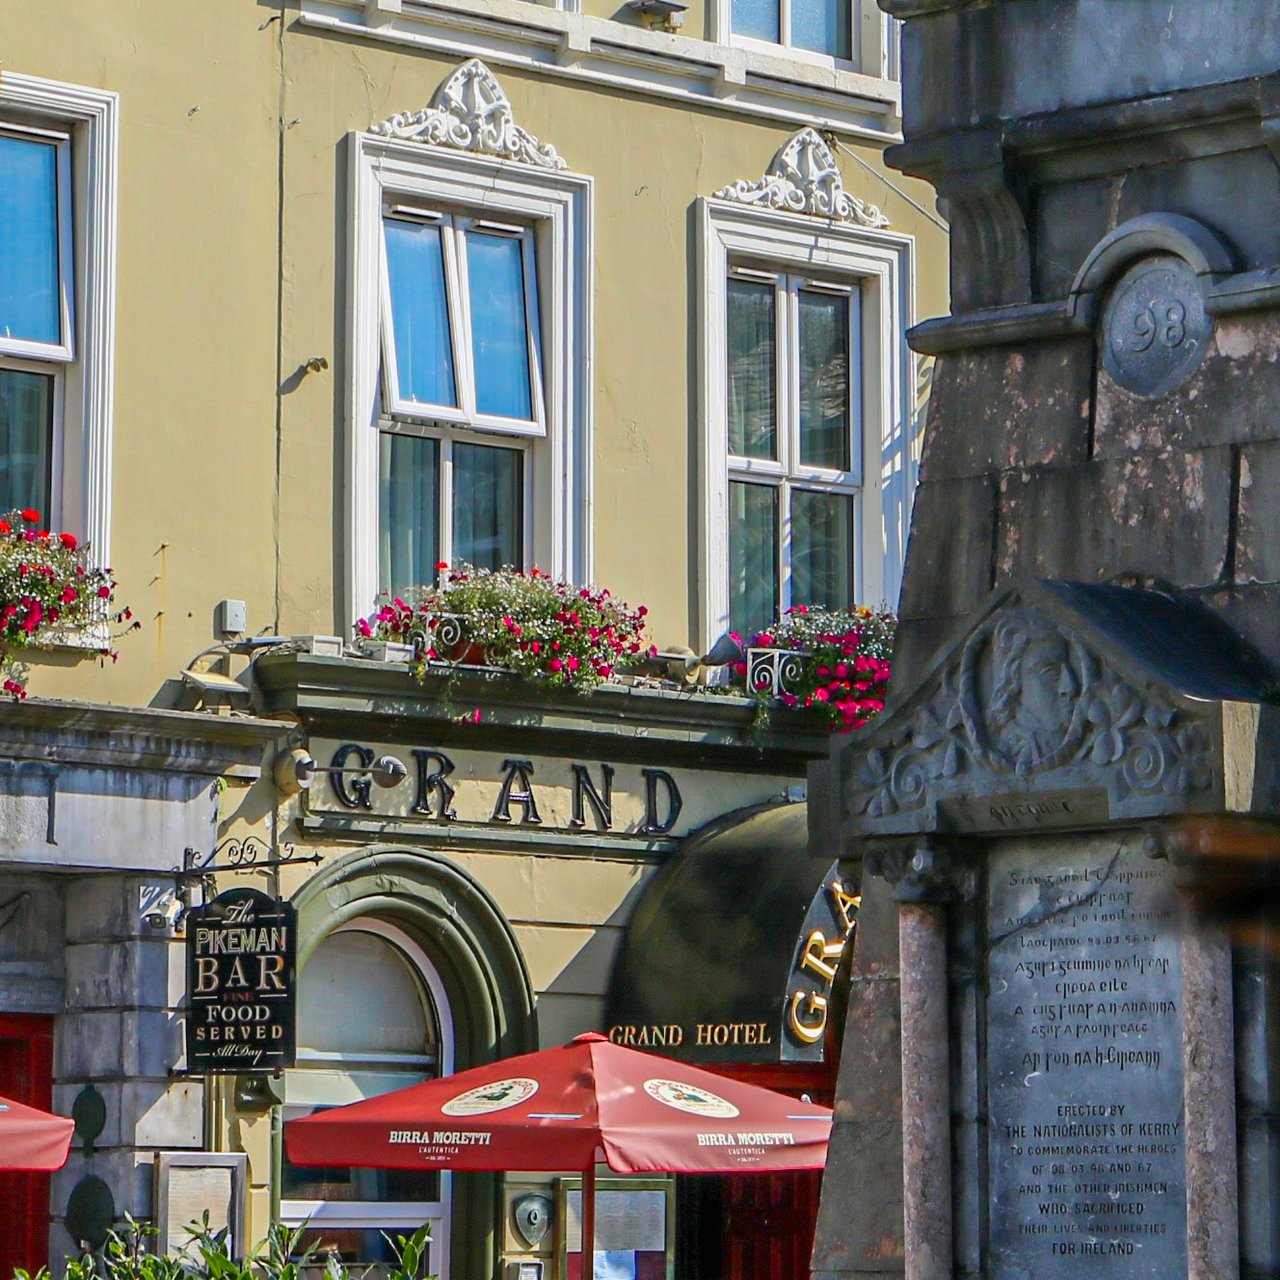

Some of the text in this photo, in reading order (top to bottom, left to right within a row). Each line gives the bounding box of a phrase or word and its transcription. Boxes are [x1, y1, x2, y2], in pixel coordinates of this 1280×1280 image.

[1131, 300, 1186, 352] 98
[329, 743, 683, 836] GRAND
[221, 898, 255, 924] The
[196, 926, 288, 954] PIKEMAN
[194, 954, 287, 993] BAR
[206, 1005, 271, 1023] FOOD
[196, 1025, 283, 1040] SERVED
[609, 1022, 771, 1047] GRAND HOTEL
[1057, 1104, 1125, 1117] ERECTED BY
[1005, 1122, 1180, 1138] THE NATIONALISTS OF KERRY
[389, 1131, 492, 1145] BIRRA MORETTI
[696, 1133, 795, 1146] BIRRA MORETTI
[418, 1146, 460, 1154] L'AUTENTICA
[1010, 1143, 1177, 1156] TO COMMEMORATE THE HEROES
[1032, 1165, 1045, 1175] OF
[1109, 1163, 1131, 1174] AND
[1019, 1182, 1168, 1194] AND THE OTHER IRISHMEN
[1039, 1202, 1145, 1215] WHO SACRIFICED
[1019, 1224, 1049, 1234] THEIR
[1052, 1242, 1134, 1256] FOR IRELAND
